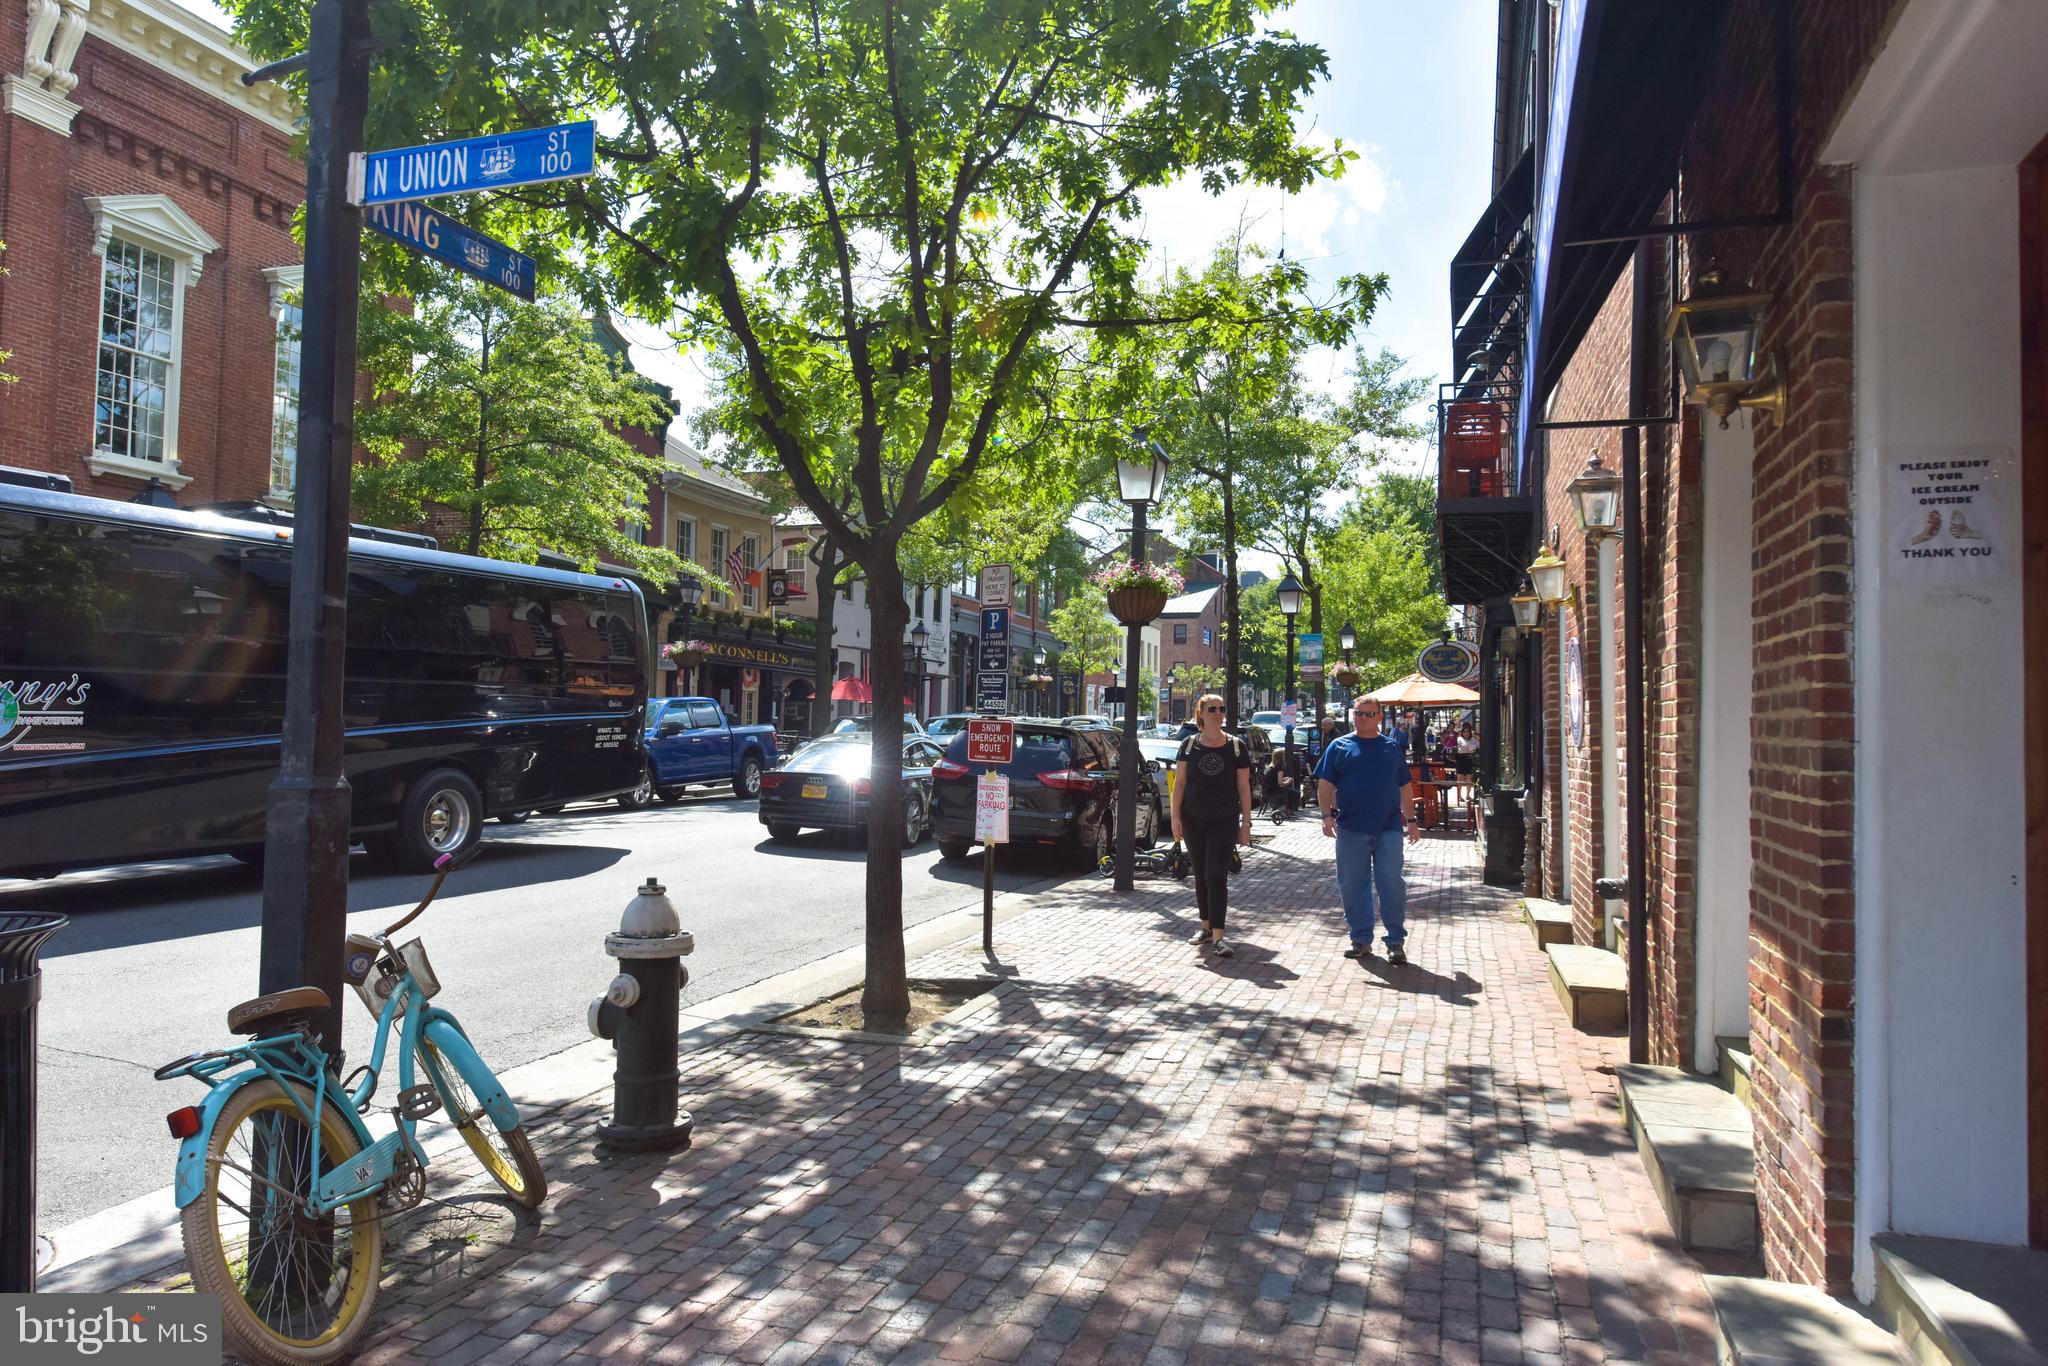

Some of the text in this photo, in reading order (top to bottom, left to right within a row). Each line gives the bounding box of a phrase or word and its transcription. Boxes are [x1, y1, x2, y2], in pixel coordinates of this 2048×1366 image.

[547, 130, 570, 152] ST
[540, 151, 572, 174] 100
[373, 146, 468, 196] N UNION
[373, 201, 440, 249] KING
[508, 255, 522, 271] ST
[501, 270, 520, 290] 100
[1900, 459, 1990, 471] PLEASE ENJOY
[1928, 472, 1963, 481] YOUR
[1911, 484, 1980, 494] ICE CREAM
[1919, 495, 1973, 505] OUTSIDE
[1901, 547, 1992, 558] THANK YOU
[990, 612, 1000, 629] P
[985, 700, 1004, 709] 44502
[17, 716, 84, 726] RANSPORTATION
[981, 723, 1001, 732] SNOW
[970, 732, 1011, 743] EMERGENCY
[979, 743, 1002, 752] ROUTE
[985, 792, 995, 800] NO
[978, 800, 1006, 810] PARKING
[356, 1167, 369, 1181] VA
